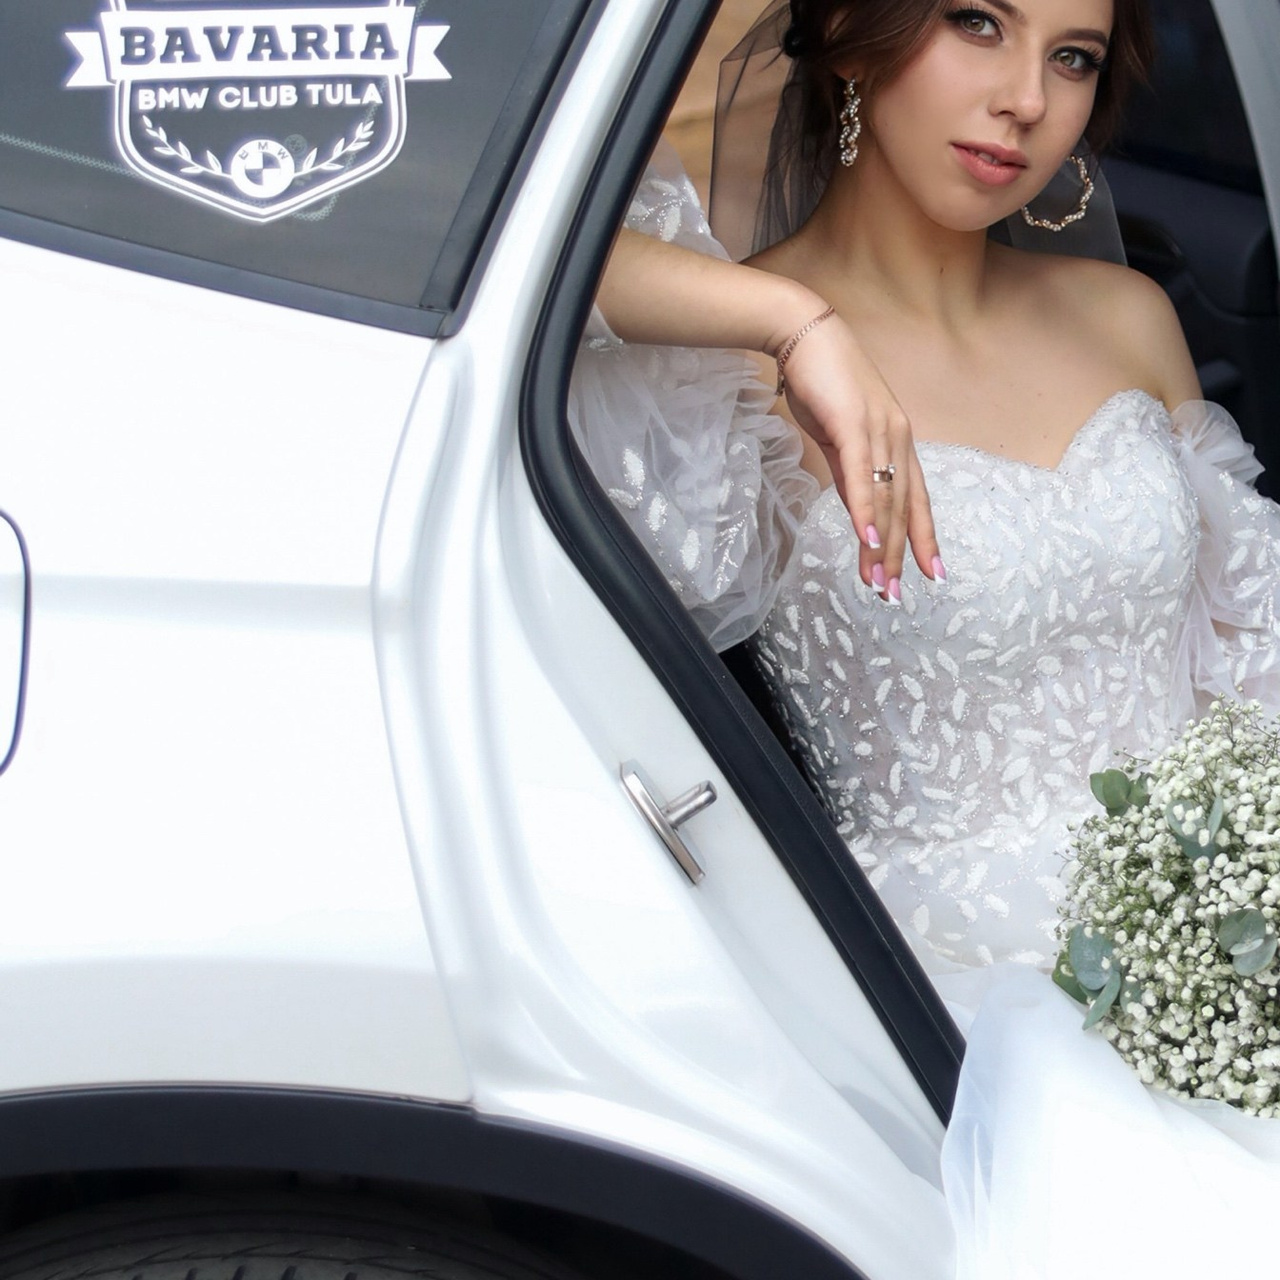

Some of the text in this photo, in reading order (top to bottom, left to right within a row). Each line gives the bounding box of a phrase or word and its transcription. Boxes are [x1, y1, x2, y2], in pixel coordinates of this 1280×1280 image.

[119, 22, 400, 66] BAVARIA
[137, 82, 383, 111] BMW CLUB TULA
[238, 141, 289, 161] BMW
